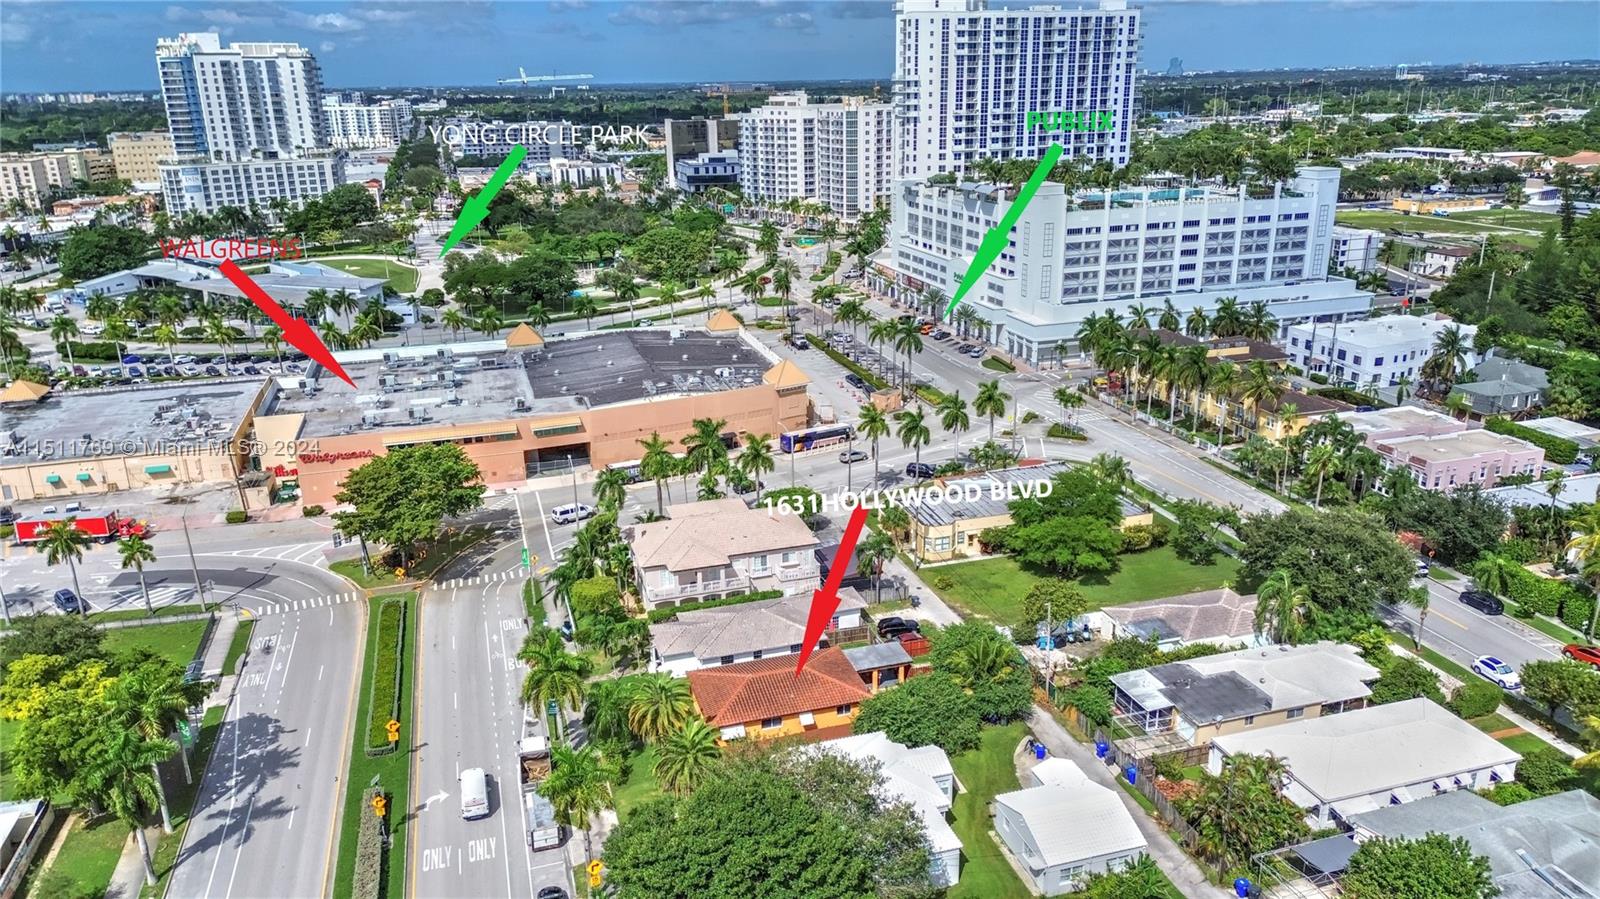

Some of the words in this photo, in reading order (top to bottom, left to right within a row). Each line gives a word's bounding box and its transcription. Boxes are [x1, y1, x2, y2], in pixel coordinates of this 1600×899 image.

[298, 450, 375, 464] Walgreens
[502, 618, 523, 631] ONLY
[422, 844, 452, 872] ONLY
[468, 836, 496, 863] ONLY
